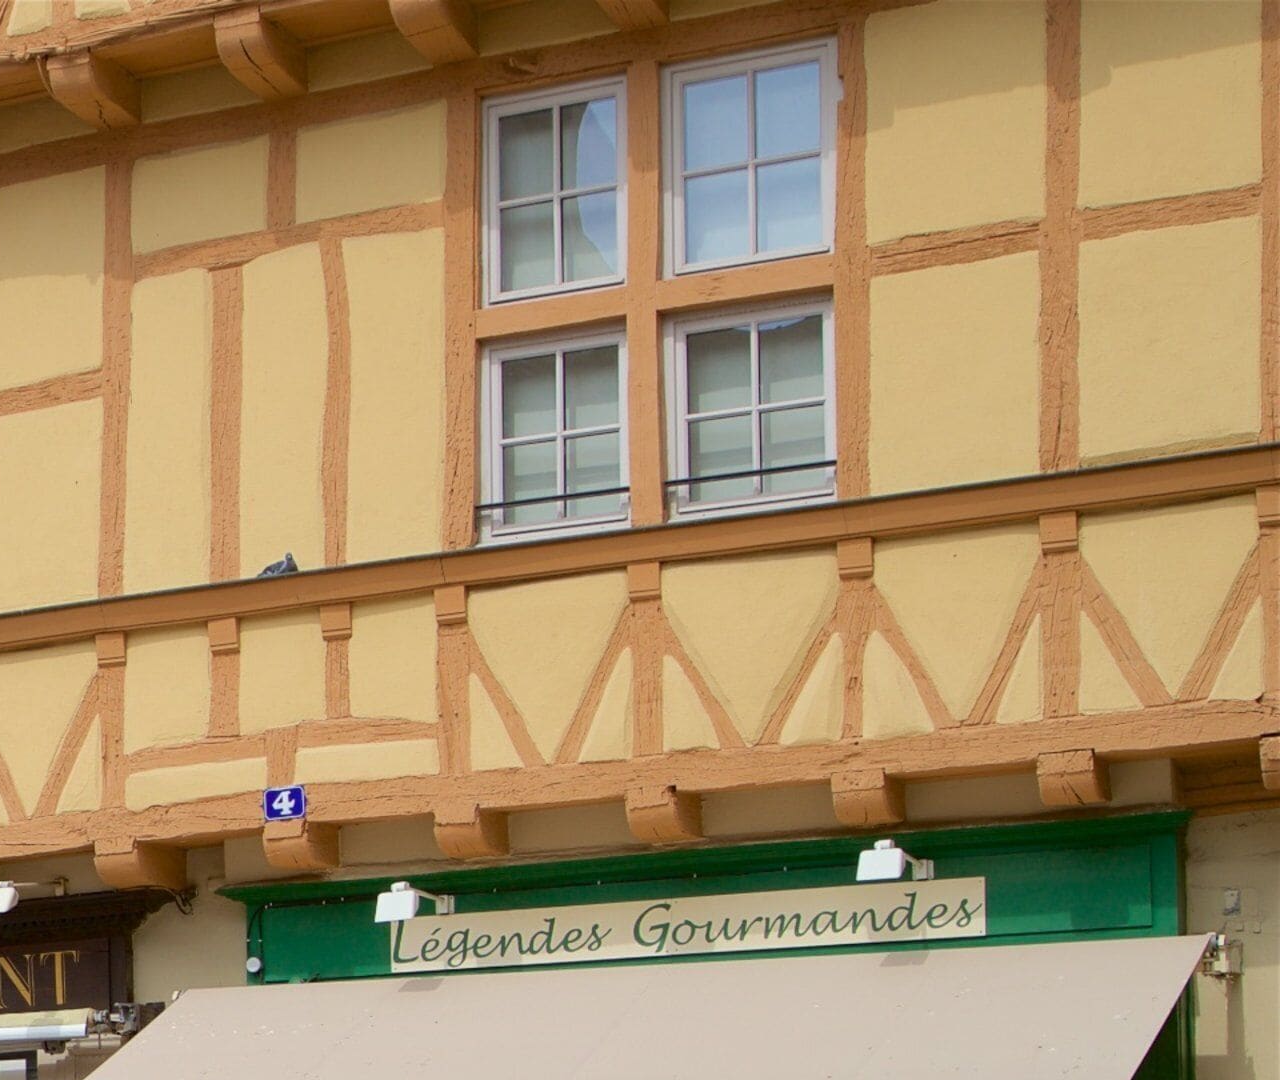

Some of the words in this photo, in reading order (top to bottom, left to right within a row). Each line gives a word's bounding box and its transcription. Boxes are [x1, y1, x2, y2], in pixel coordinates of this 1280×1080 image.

[272, 790, 296, 815] 4
[392, 917, 613, 968] Légendes
[632, 891, 983, 954] Gourmandes
